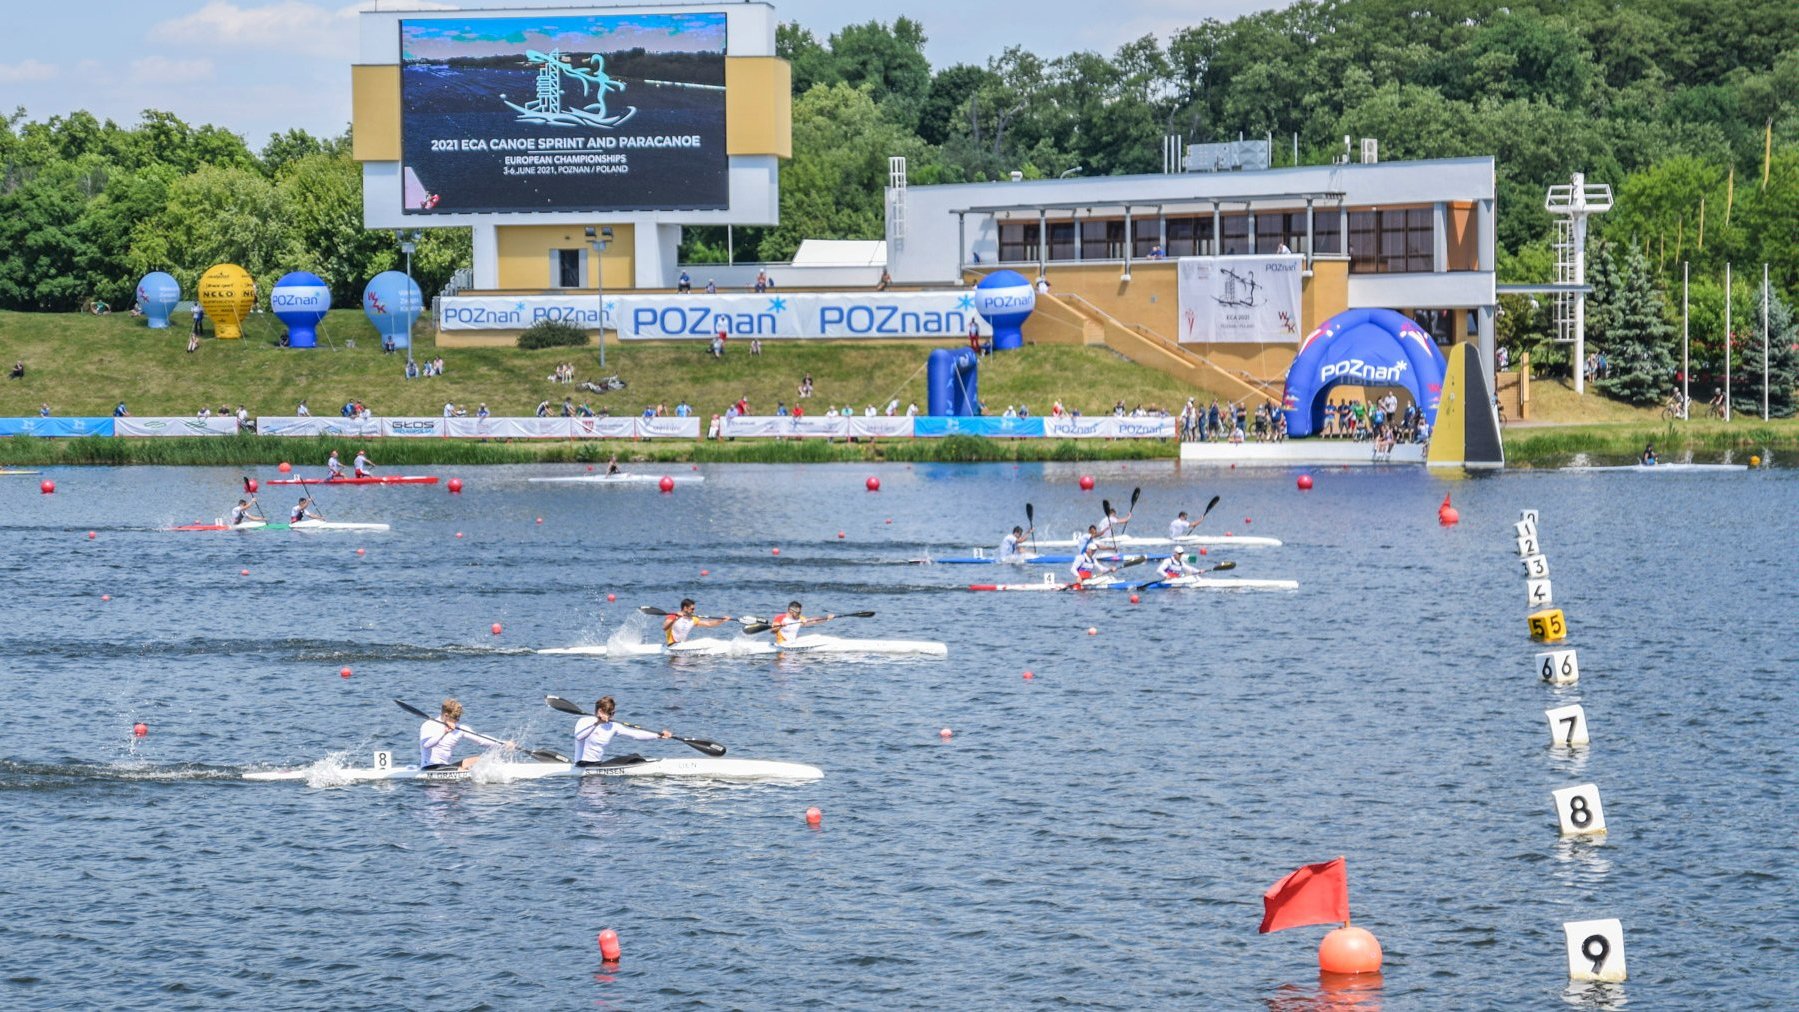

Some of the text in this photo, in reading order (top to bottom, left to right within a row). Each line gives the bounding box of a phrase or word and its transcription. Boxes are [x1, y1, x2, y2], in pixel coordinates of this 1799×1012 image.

[431, 135, 700, 151] 2021 ECA CANOE SPRINT AND PARACANOE
[505, 154, 627, 165] EUROPEAN CHAMPIONSHIPS
[596, 164, 629, 173] POLAND
[1524, 523, 1531, 535] 1
[1525, 539, 1534, 552] 2
[1533, 559, 1544, 574] 3
[1534, 584, 1546, 600] 4
[1532, 619, 1545, 637] 5
[1550, 614, 1561, 635] 5
[1542, 657, 1553, 680] 6
[1561, 655, 1572, 676] 6
[1559, 715, 1578, 744] 7
[379, 752, 387, 767] 8
[1570, 795, 1593, 829] 8
[1582, 934, 1611, 976] 9
